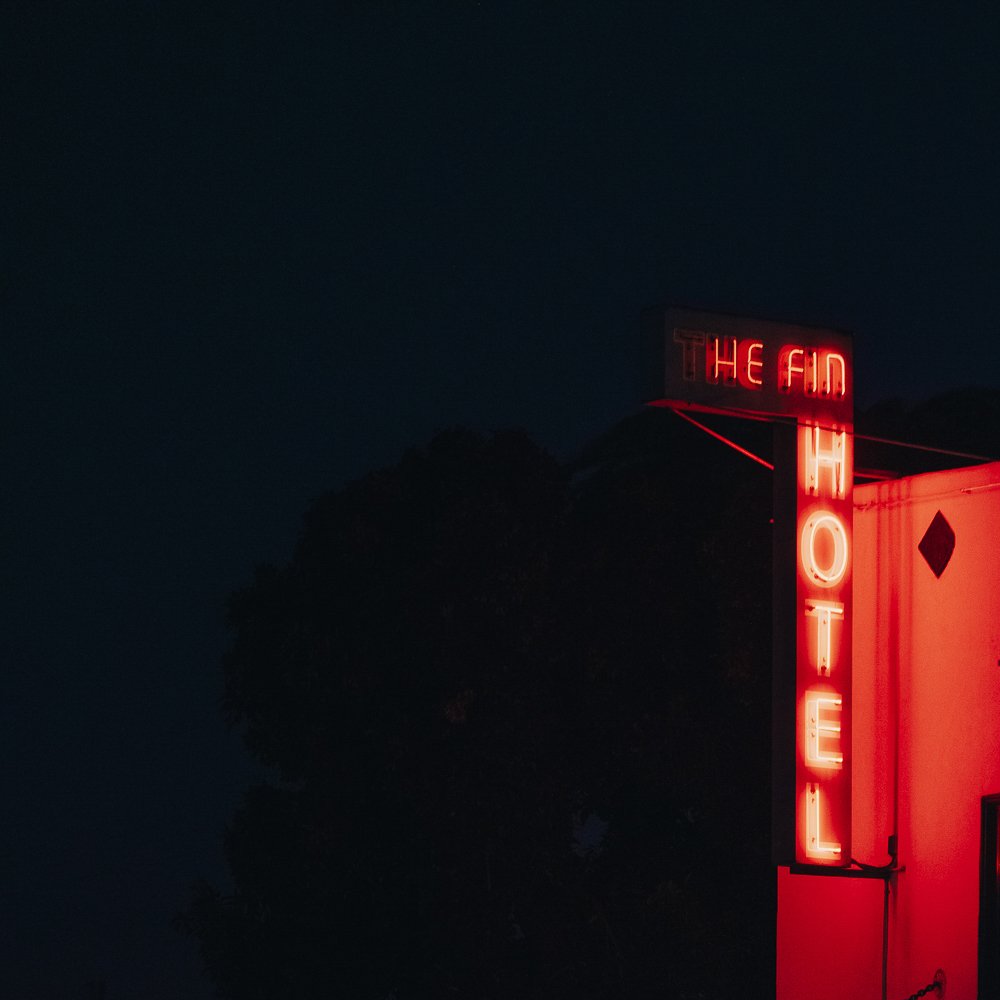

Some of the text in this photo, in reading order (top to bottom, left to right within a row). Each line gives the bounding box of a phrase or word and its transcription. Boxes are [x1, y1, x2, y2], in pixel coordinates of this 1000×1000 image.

[673, 328, 846, 400] THE FIN
[801, 419, 849, 862] HOTEL
